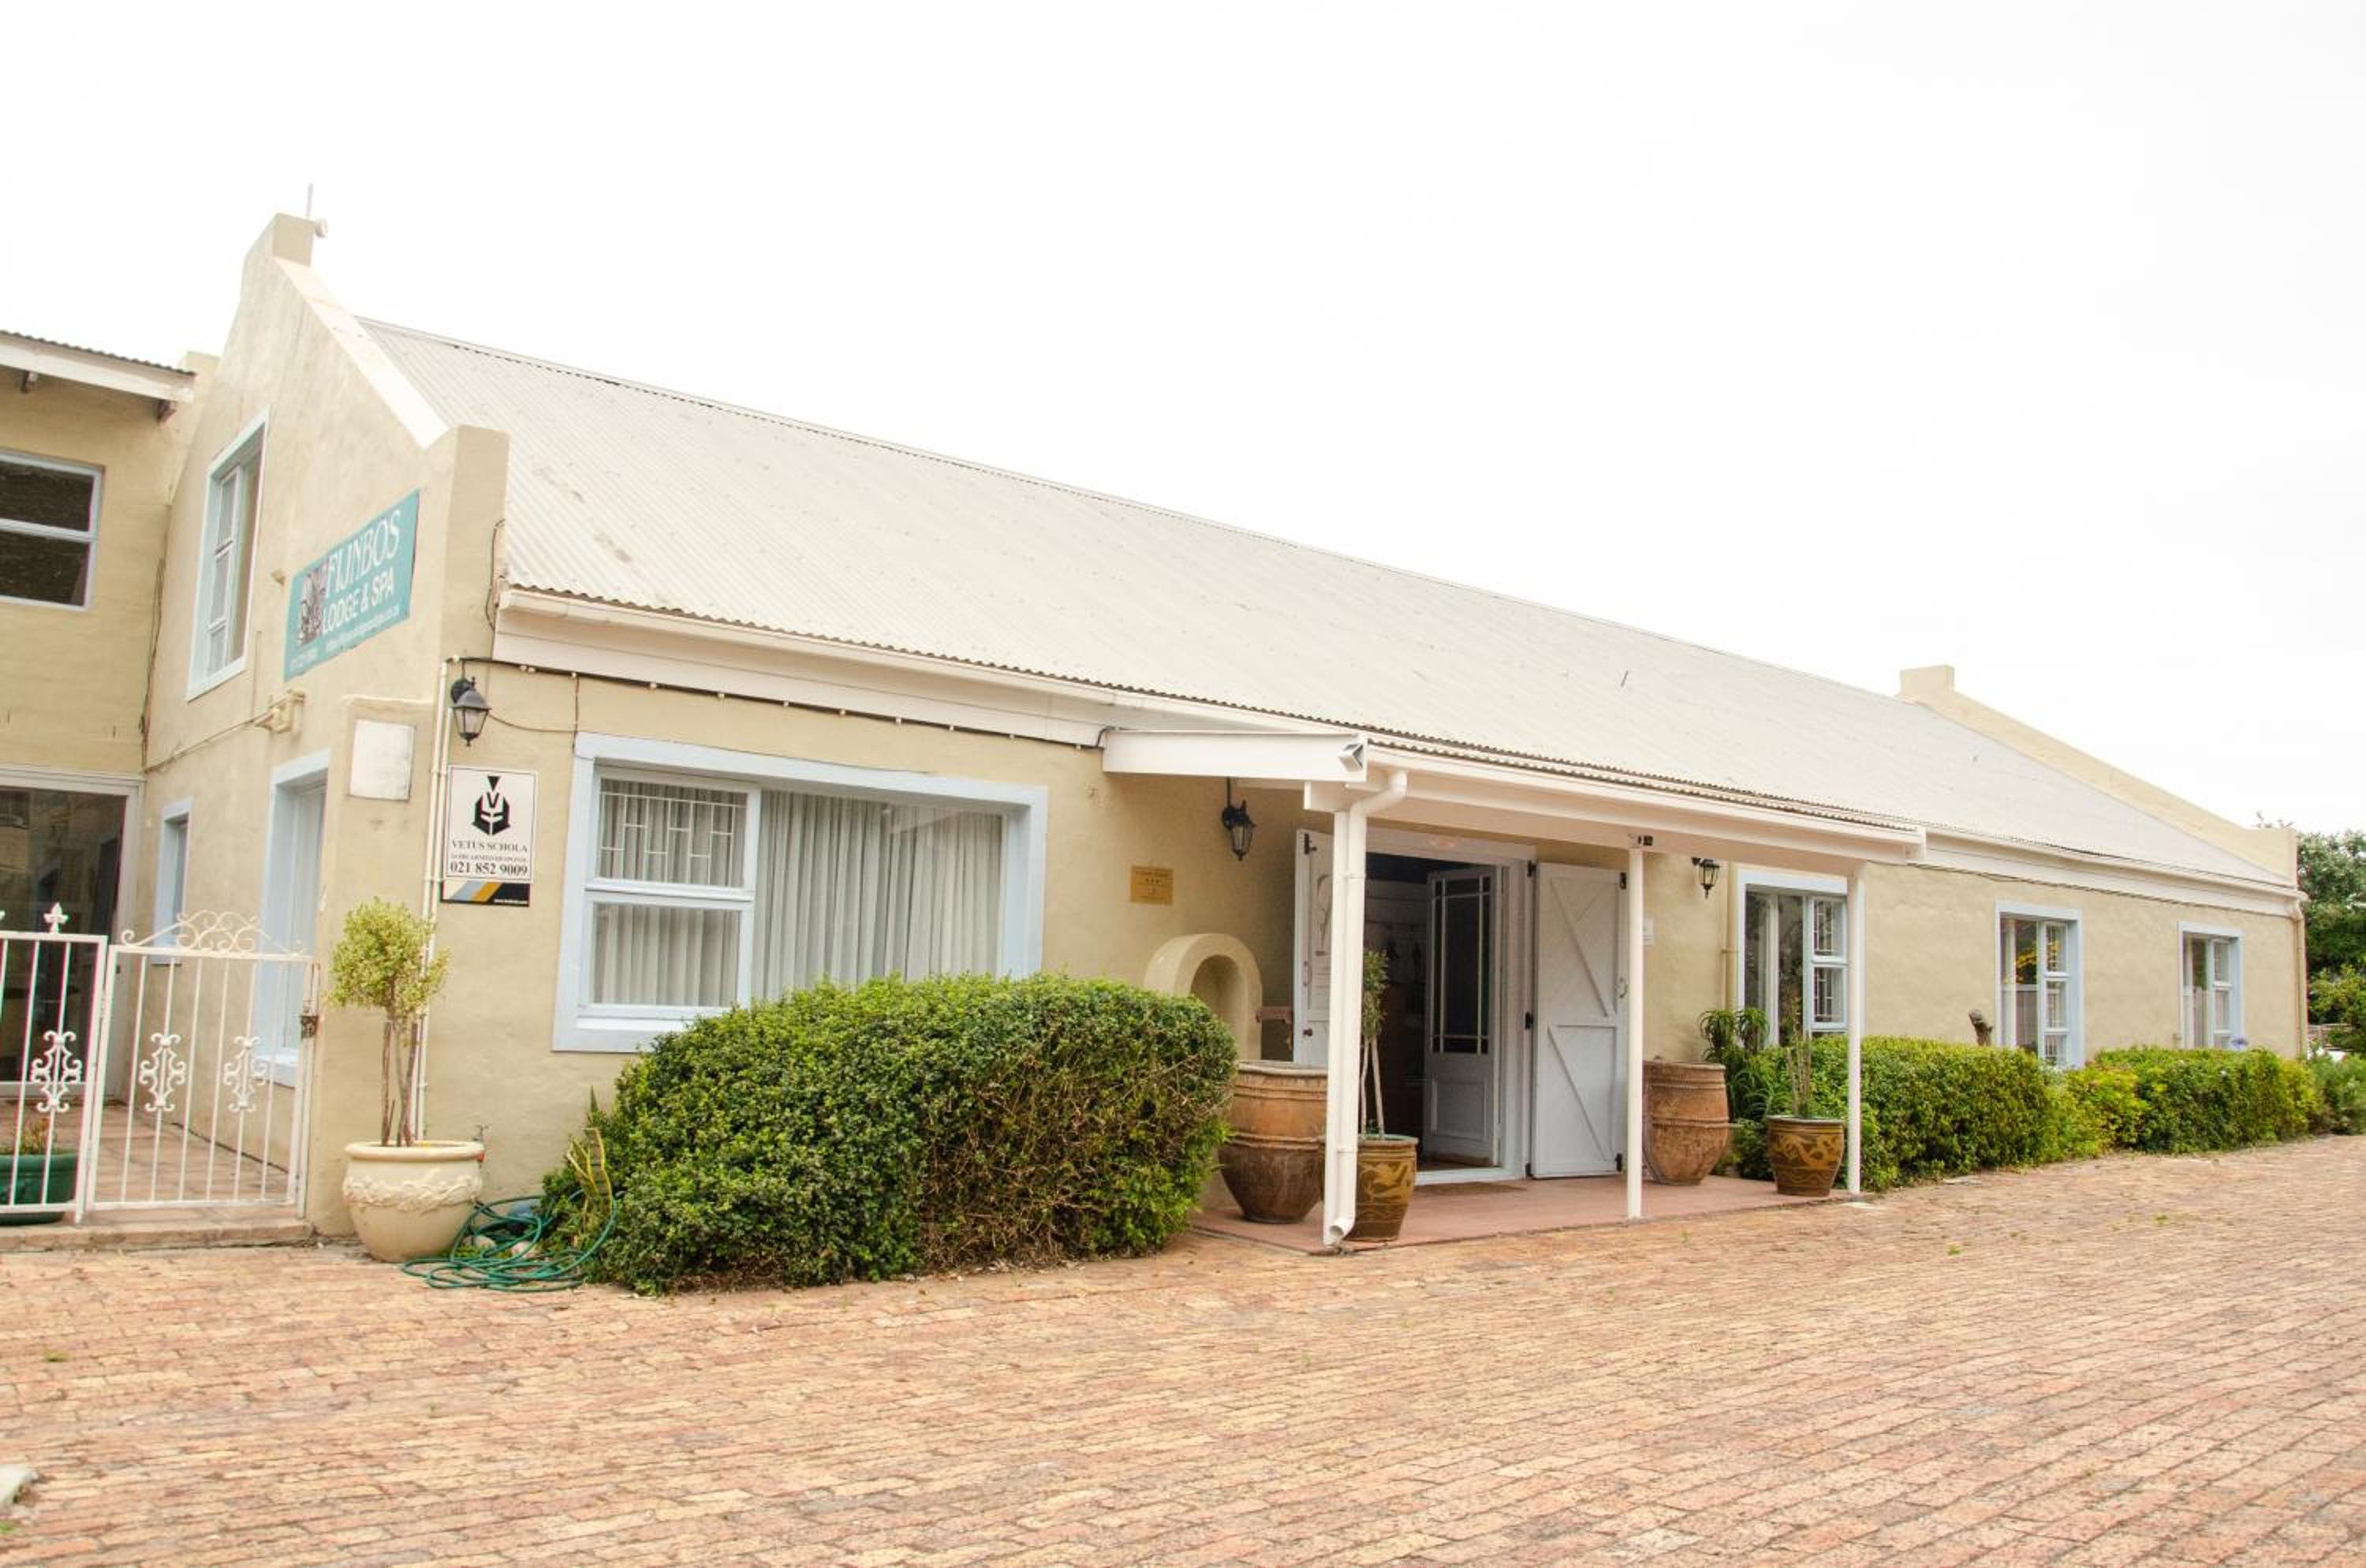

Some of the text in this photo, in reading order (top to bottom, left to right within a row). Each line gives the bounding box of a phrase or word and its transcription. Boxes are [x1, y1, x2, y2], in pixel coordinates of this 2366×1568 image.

[323, 587, 360, 635] LODGE
[360, 581, 370, 613] &
[372, 566, 394, 606] SPA
[452, 838, 528, 853] VETUS SCHOLA
[450, 860, 528, 876] 021 852 9009
